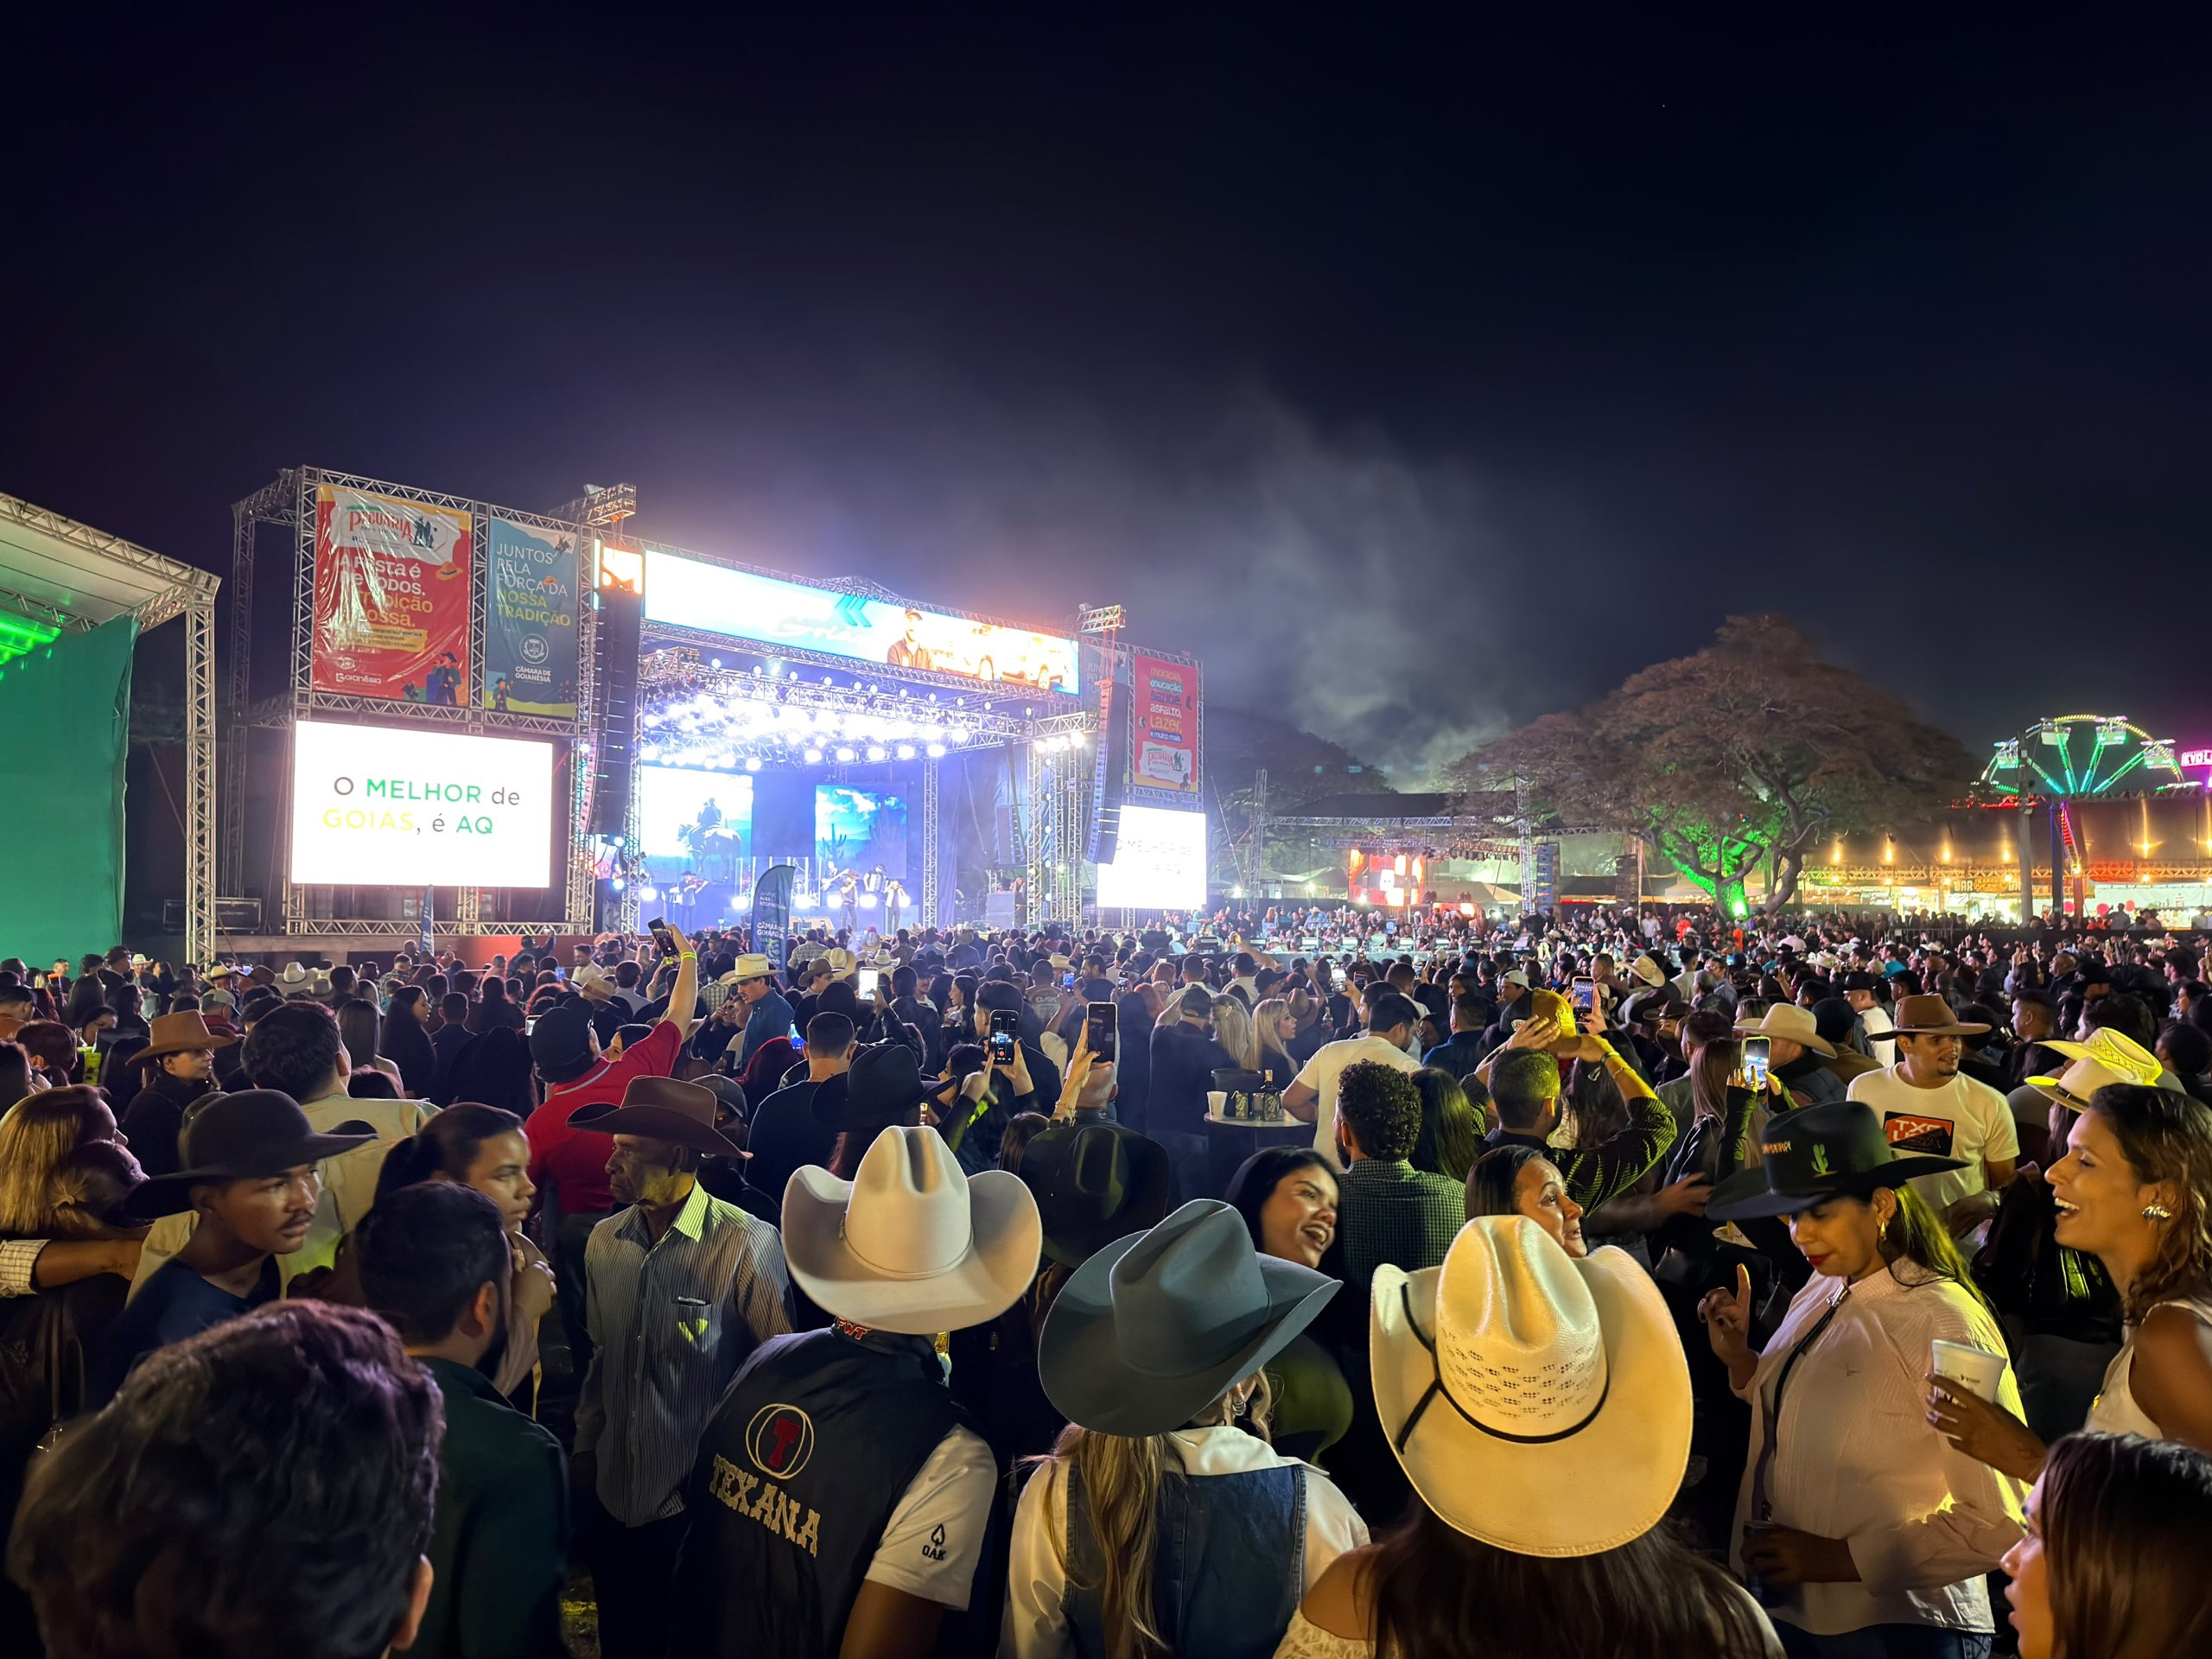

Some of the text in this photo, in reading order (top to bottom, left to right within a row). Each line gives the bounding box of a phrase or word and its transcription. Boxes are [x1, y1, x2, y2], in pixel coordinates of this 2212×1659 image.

[497, 543, 553, 564] JUNTOS
[497, 557, 531, 575] PELA
[370, 574, 425, 596] ODOS.
[497, 574, 568, 597] FORÇA DA
[497, 589, 547, 607] NOSSA
[497, 603, 570, 626] TRADIÇÃO
[516, 665, 542, 675] CÂMARA
[334, 777, 520, 805] O MELHOR de
[432, 813, 445, 832] é
[456, 816, 493, 834] AQ
[709, 1452, 821, 1558] TEXANA
[921, 1545, 948, 1560] OAK
